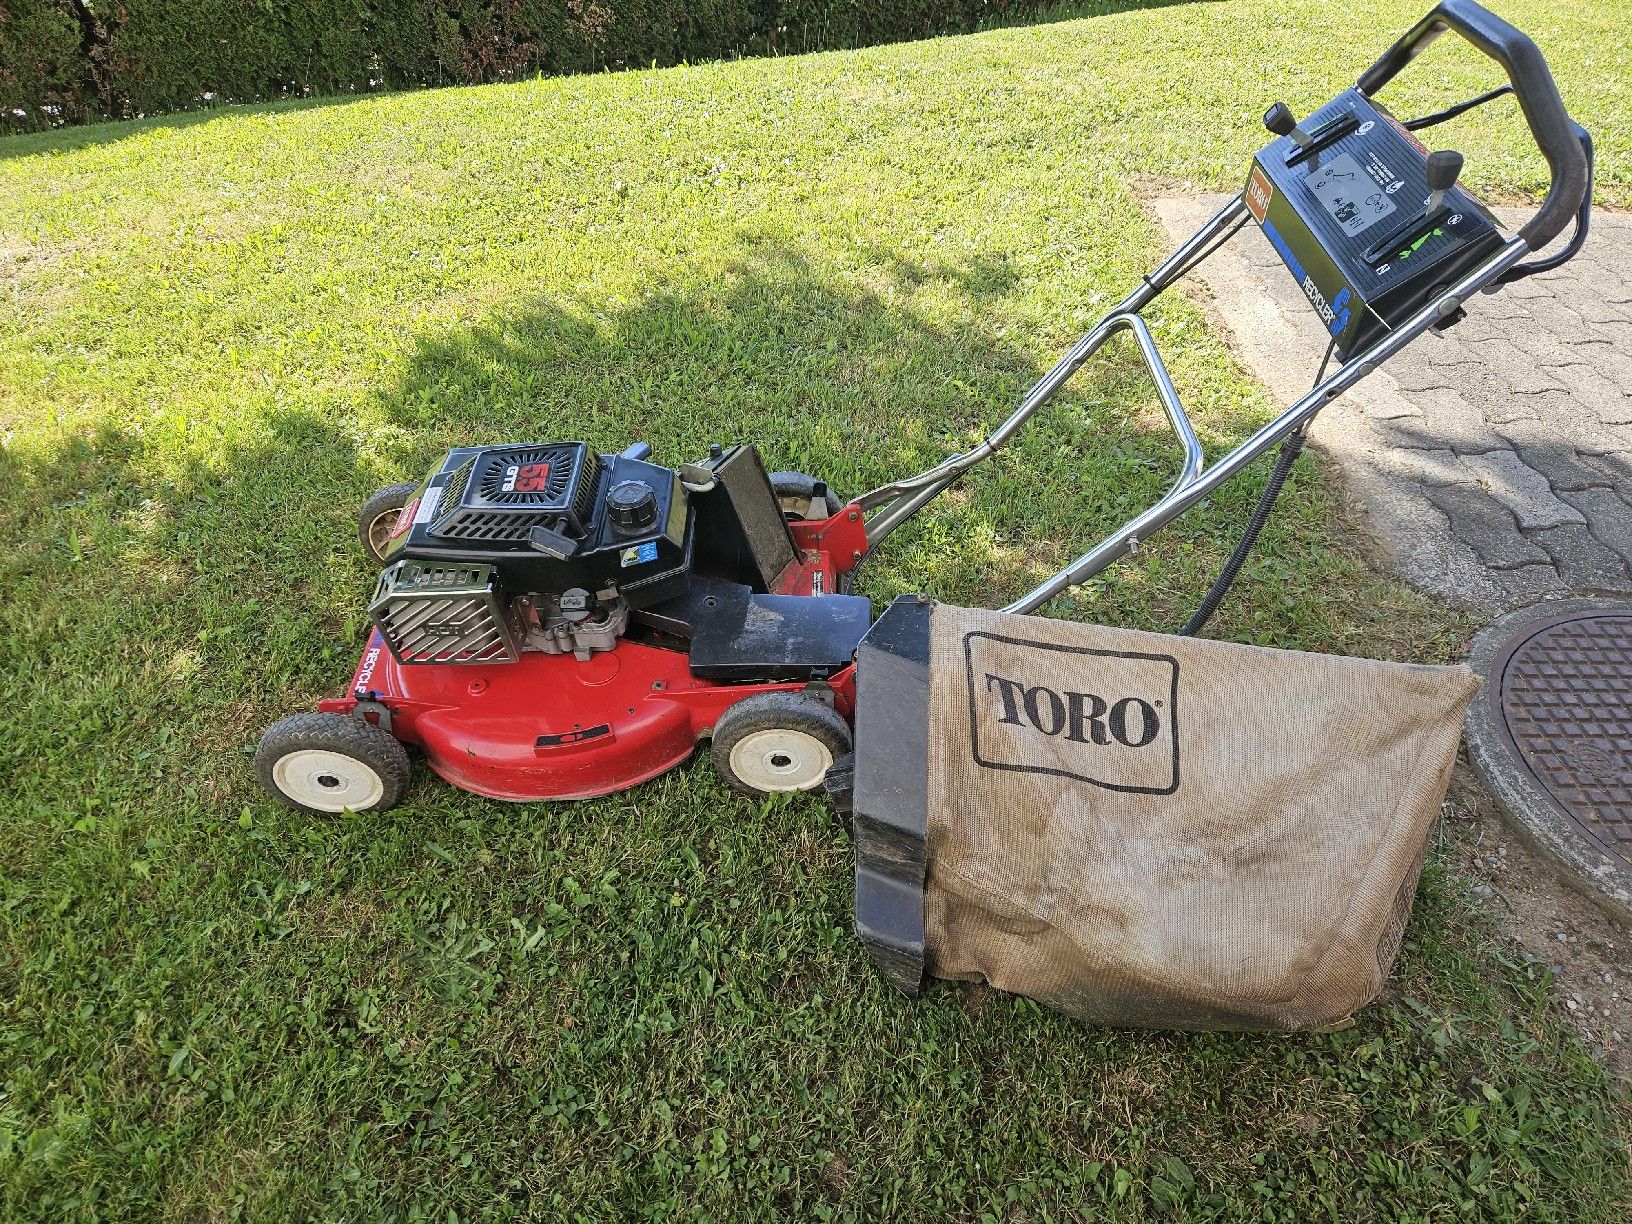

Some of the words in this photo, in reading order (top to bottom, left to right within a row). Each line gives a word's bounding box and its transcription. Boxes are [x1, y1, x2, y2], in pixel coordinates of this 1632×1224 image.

[1302, 275, 1335, 325] RECYCLER
[515, 463, 550, 492] 55
[354, 648, 381, 694] RECYCLE
[985, 673, 1161, 748] TORO
